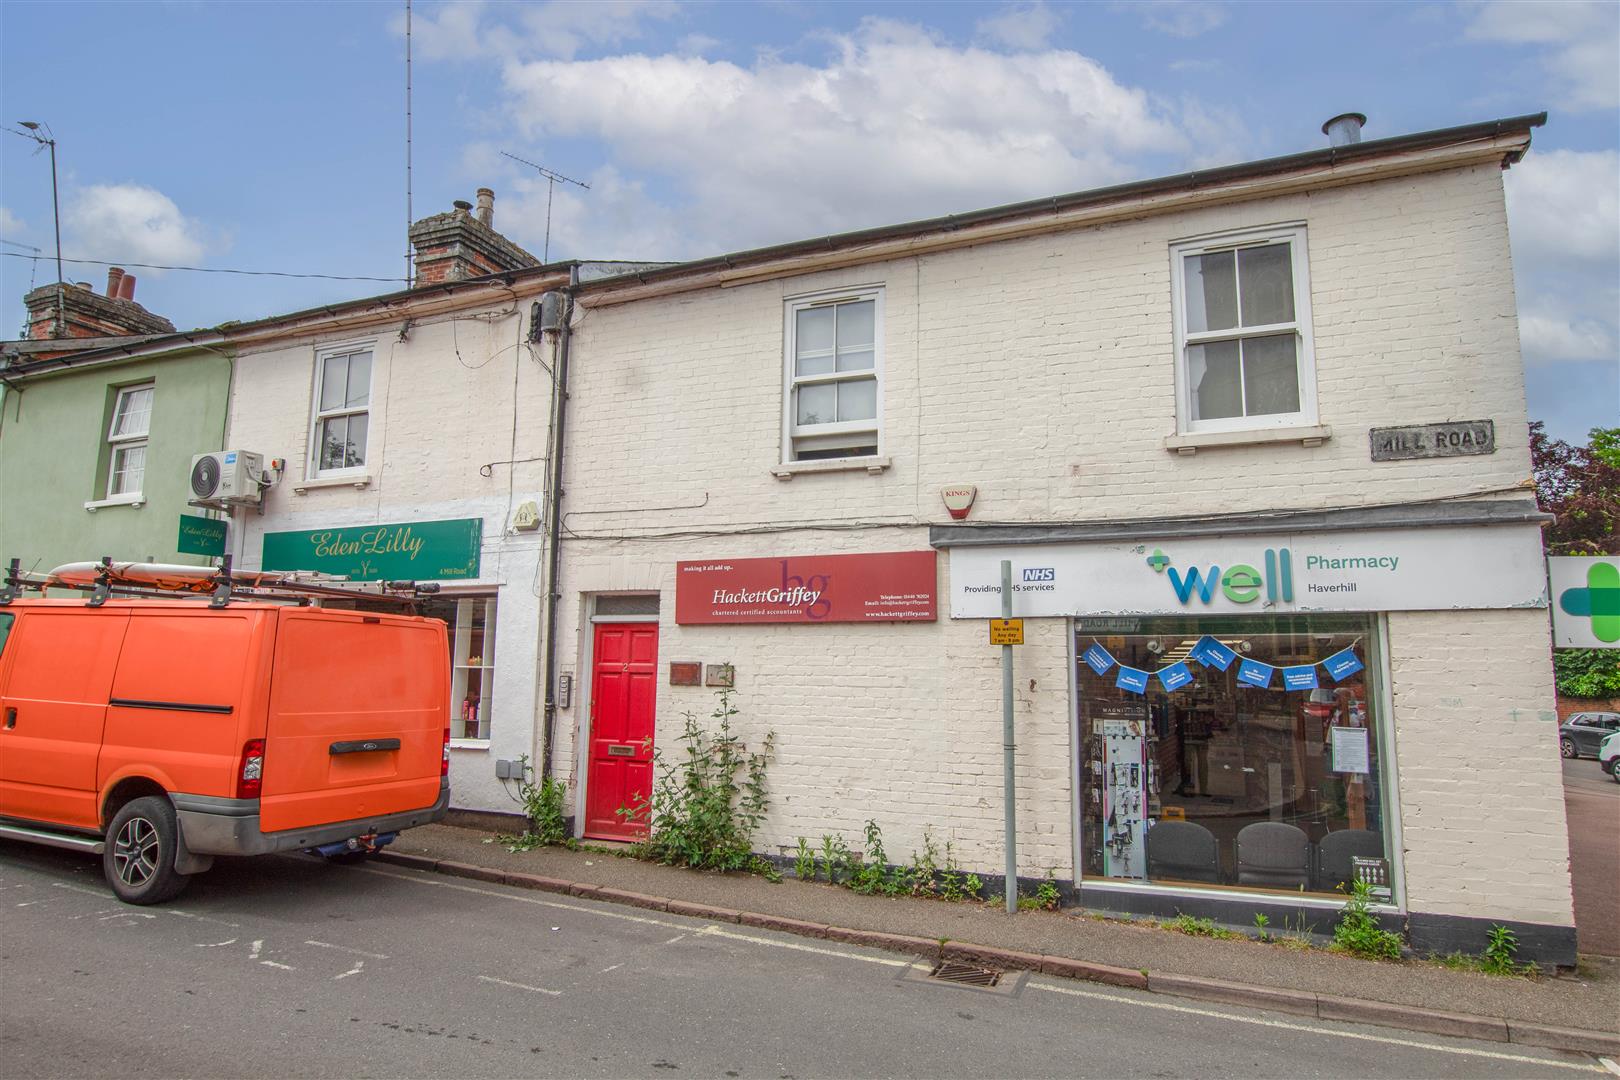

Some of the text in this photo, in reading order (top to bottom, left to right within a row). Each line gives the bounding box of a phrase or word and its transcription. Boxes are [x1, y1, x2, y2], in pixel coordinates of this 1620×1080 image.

[1436, 429, 1486, 448] ROAD
[311, 527, 425, 560] Eden Lilly
[1306, 555, 1399, 571] Pharmacy
[1024, 568, 1054, 581] NHS
[1167, 548, 1294, 605] well
[964, 585, 1002, 593] Providing
[1022, 584, 1055, 592] services
[1308, 582, 1357, 593] Haverhill
